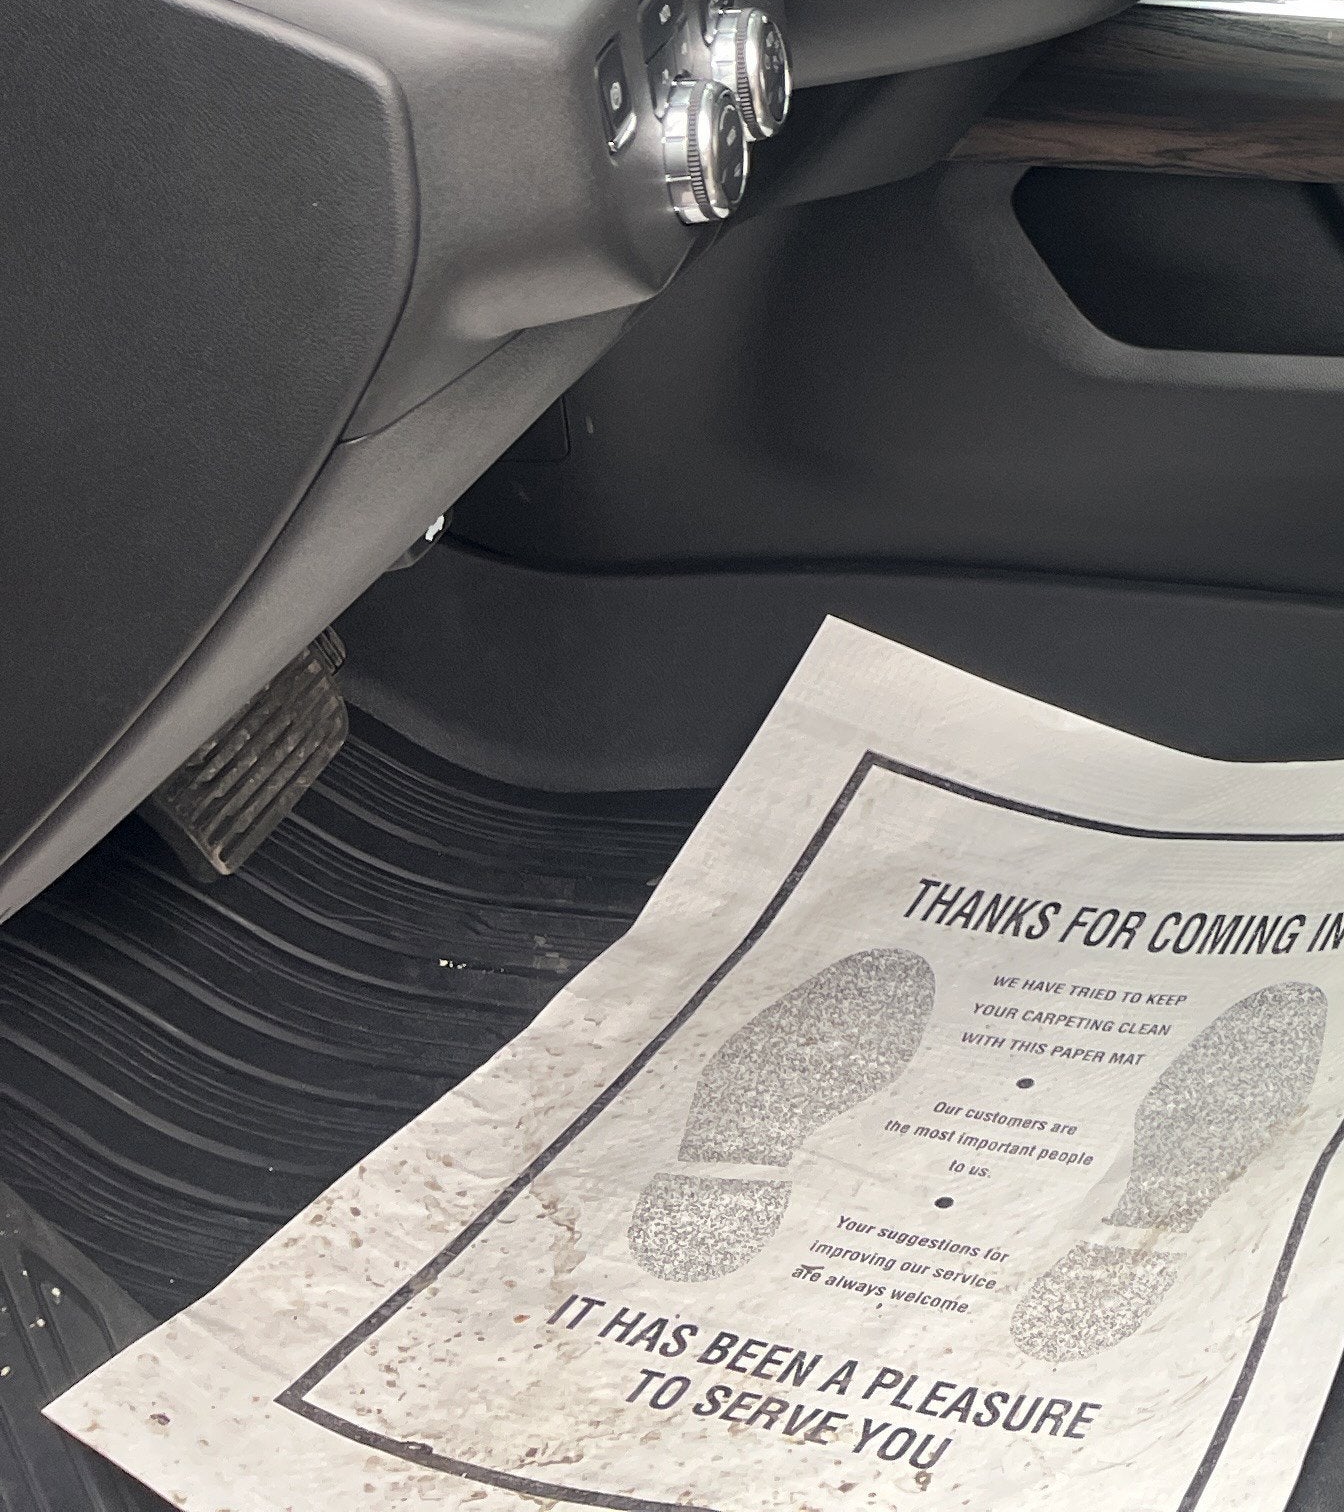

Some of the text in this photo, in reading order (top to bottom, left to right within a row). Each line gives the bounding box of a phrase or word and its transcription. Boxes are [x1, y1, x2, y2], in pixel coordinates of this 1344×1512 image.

[903, 877, 1063, 940] THANKS
[1057, 906, 1148, 950] FOR
[1146, 911, 1307, 955] COMING
[993, 975, 1188, 1006] WE HAVE TRIED TO KEEP
[973, 1002, 1172, 1036] YOUR CARPETING CLEAN
[961, 1031, 1147, 1066] WITH THIS PAPER MAT
[932, 1101, 1078, 1136] Our customers are
[884, 1119, 1094, 1166] the most important people
[948, 1159, 966, 1173] to
[836, 1215, 1010, 1263] Your suggestions for
[791, 1263, 826, 1283] are
[824, 1275, 887, 1297] always
[808, 1239, 997, 1290] improving our service
[545, 1293, 1103, 1442] IT HAS BEEN A PLEASURE
[625, 1368, 954, 1471] TO SERVE YOU
